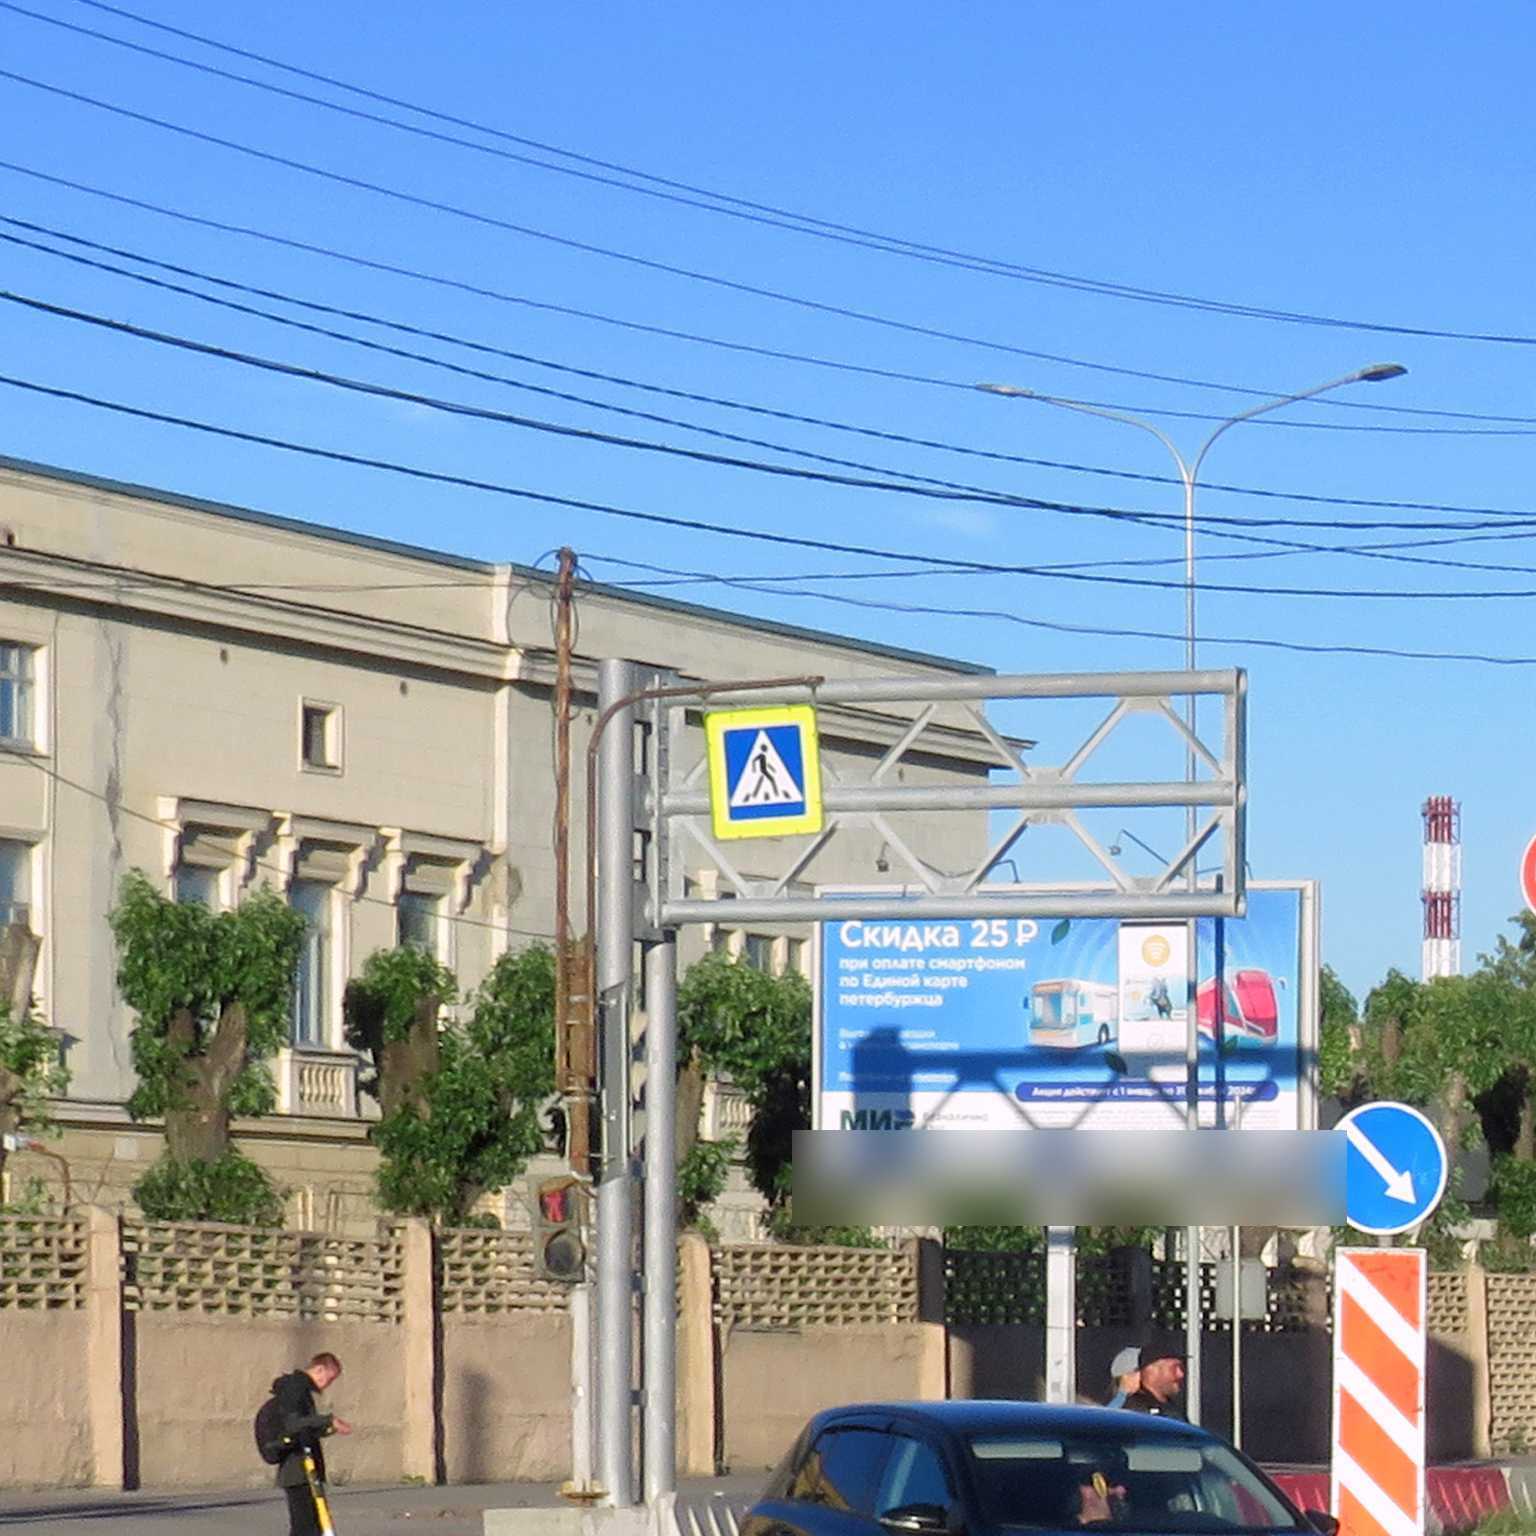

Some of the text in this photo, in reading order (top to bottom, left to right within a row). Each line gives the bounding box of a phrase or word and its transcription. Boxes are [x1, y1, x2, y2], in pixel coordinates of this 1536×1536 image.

[839, 920, 961, 951] Скидка
[970, 920, 1010, 948] 25
[839, 956, 1026, 972] при оплате смартфоном
[839, 974, 968, 991] по Единой карте
[839, 993, 944, 1008] петербуржца
